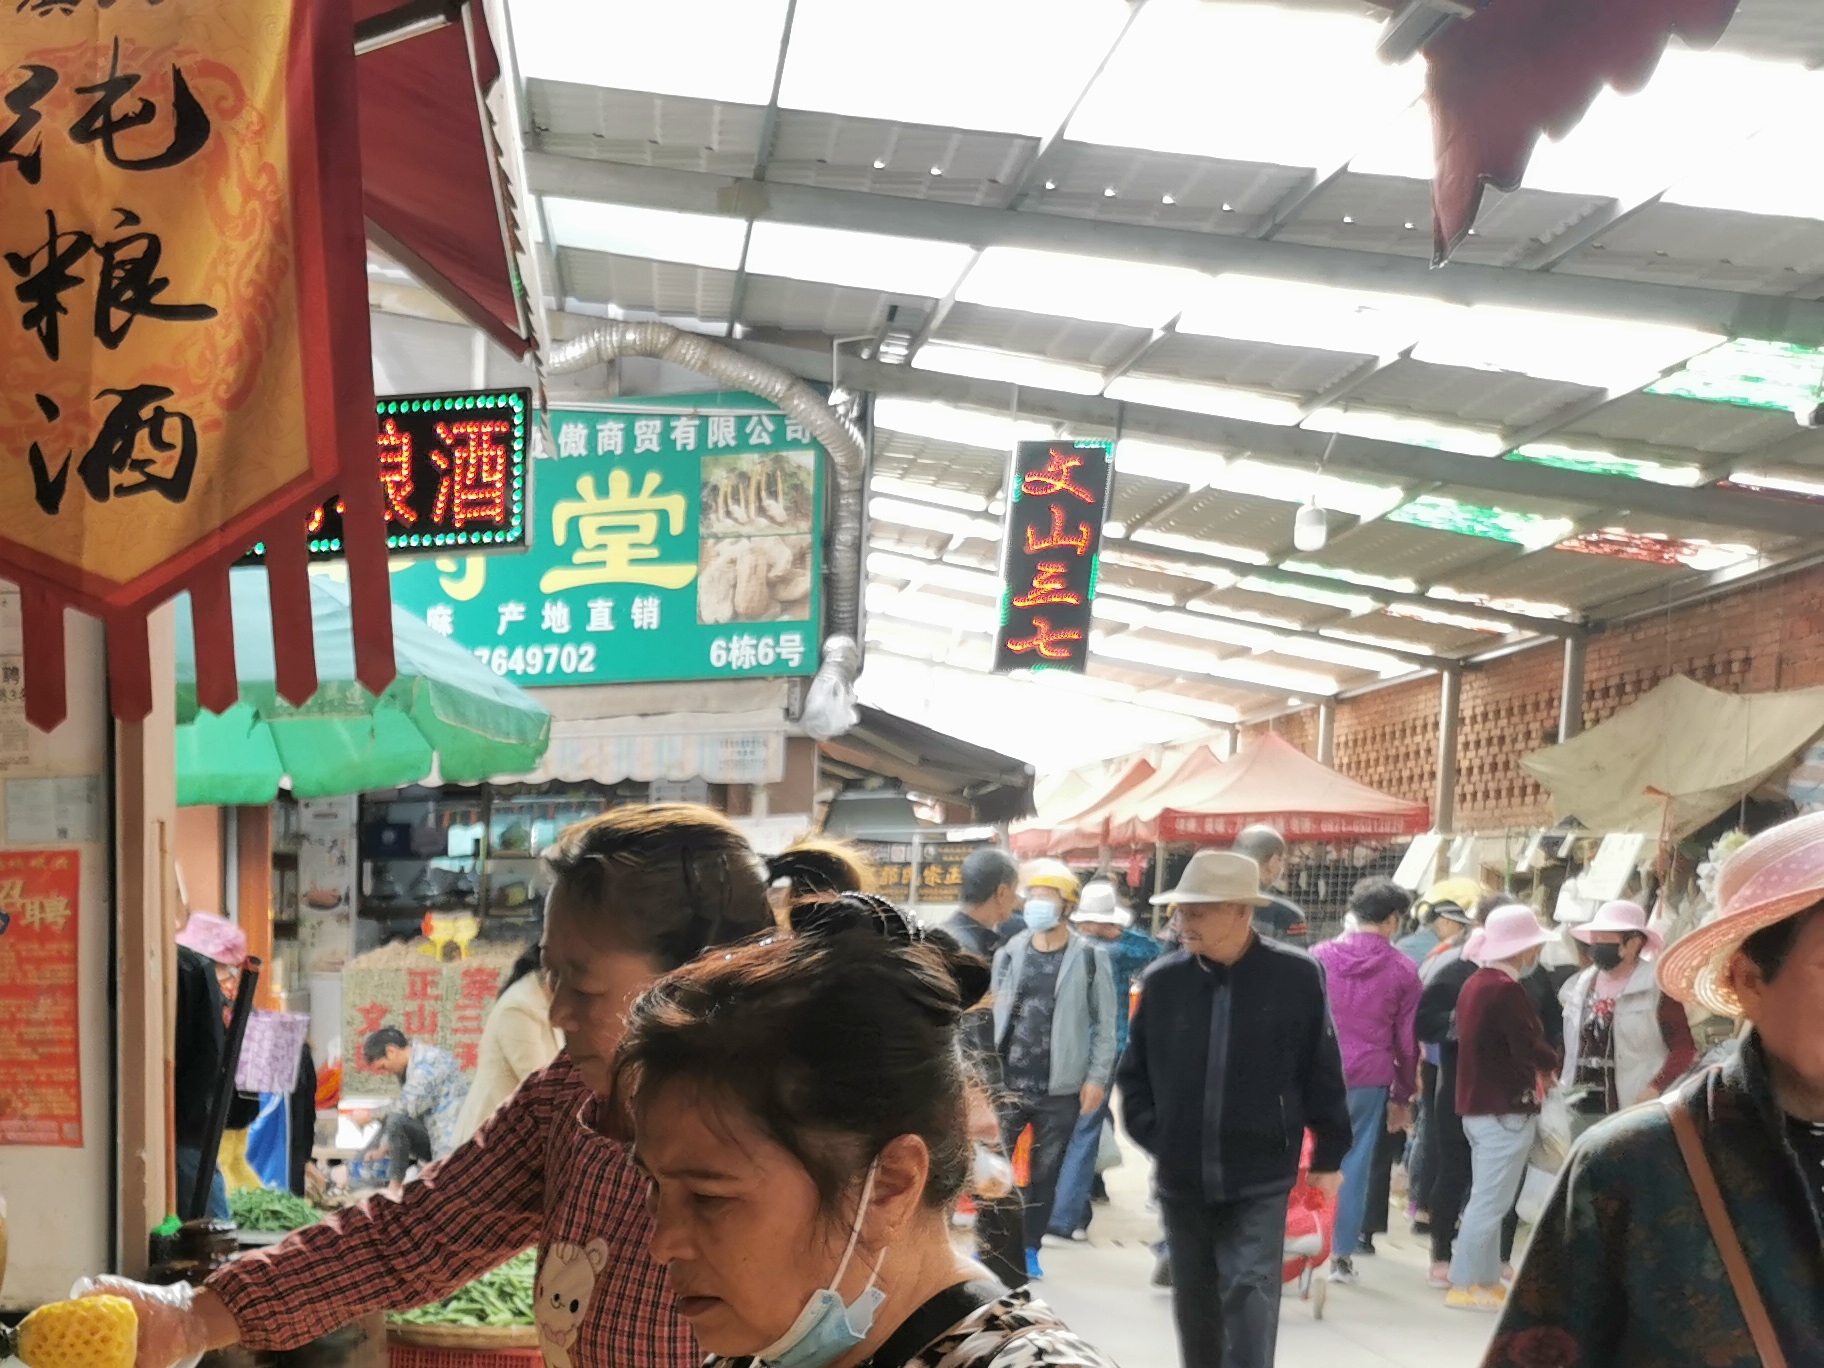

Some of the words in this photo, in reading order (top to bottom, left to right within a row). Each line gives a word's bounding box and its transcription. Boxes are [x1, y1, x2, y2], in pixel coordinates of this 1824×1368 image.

[1006, 447, 1095, 659] 文山三七
[497, 597, 661, 635] 产地直销
[709, 632, 805, 669] 6栋6号
